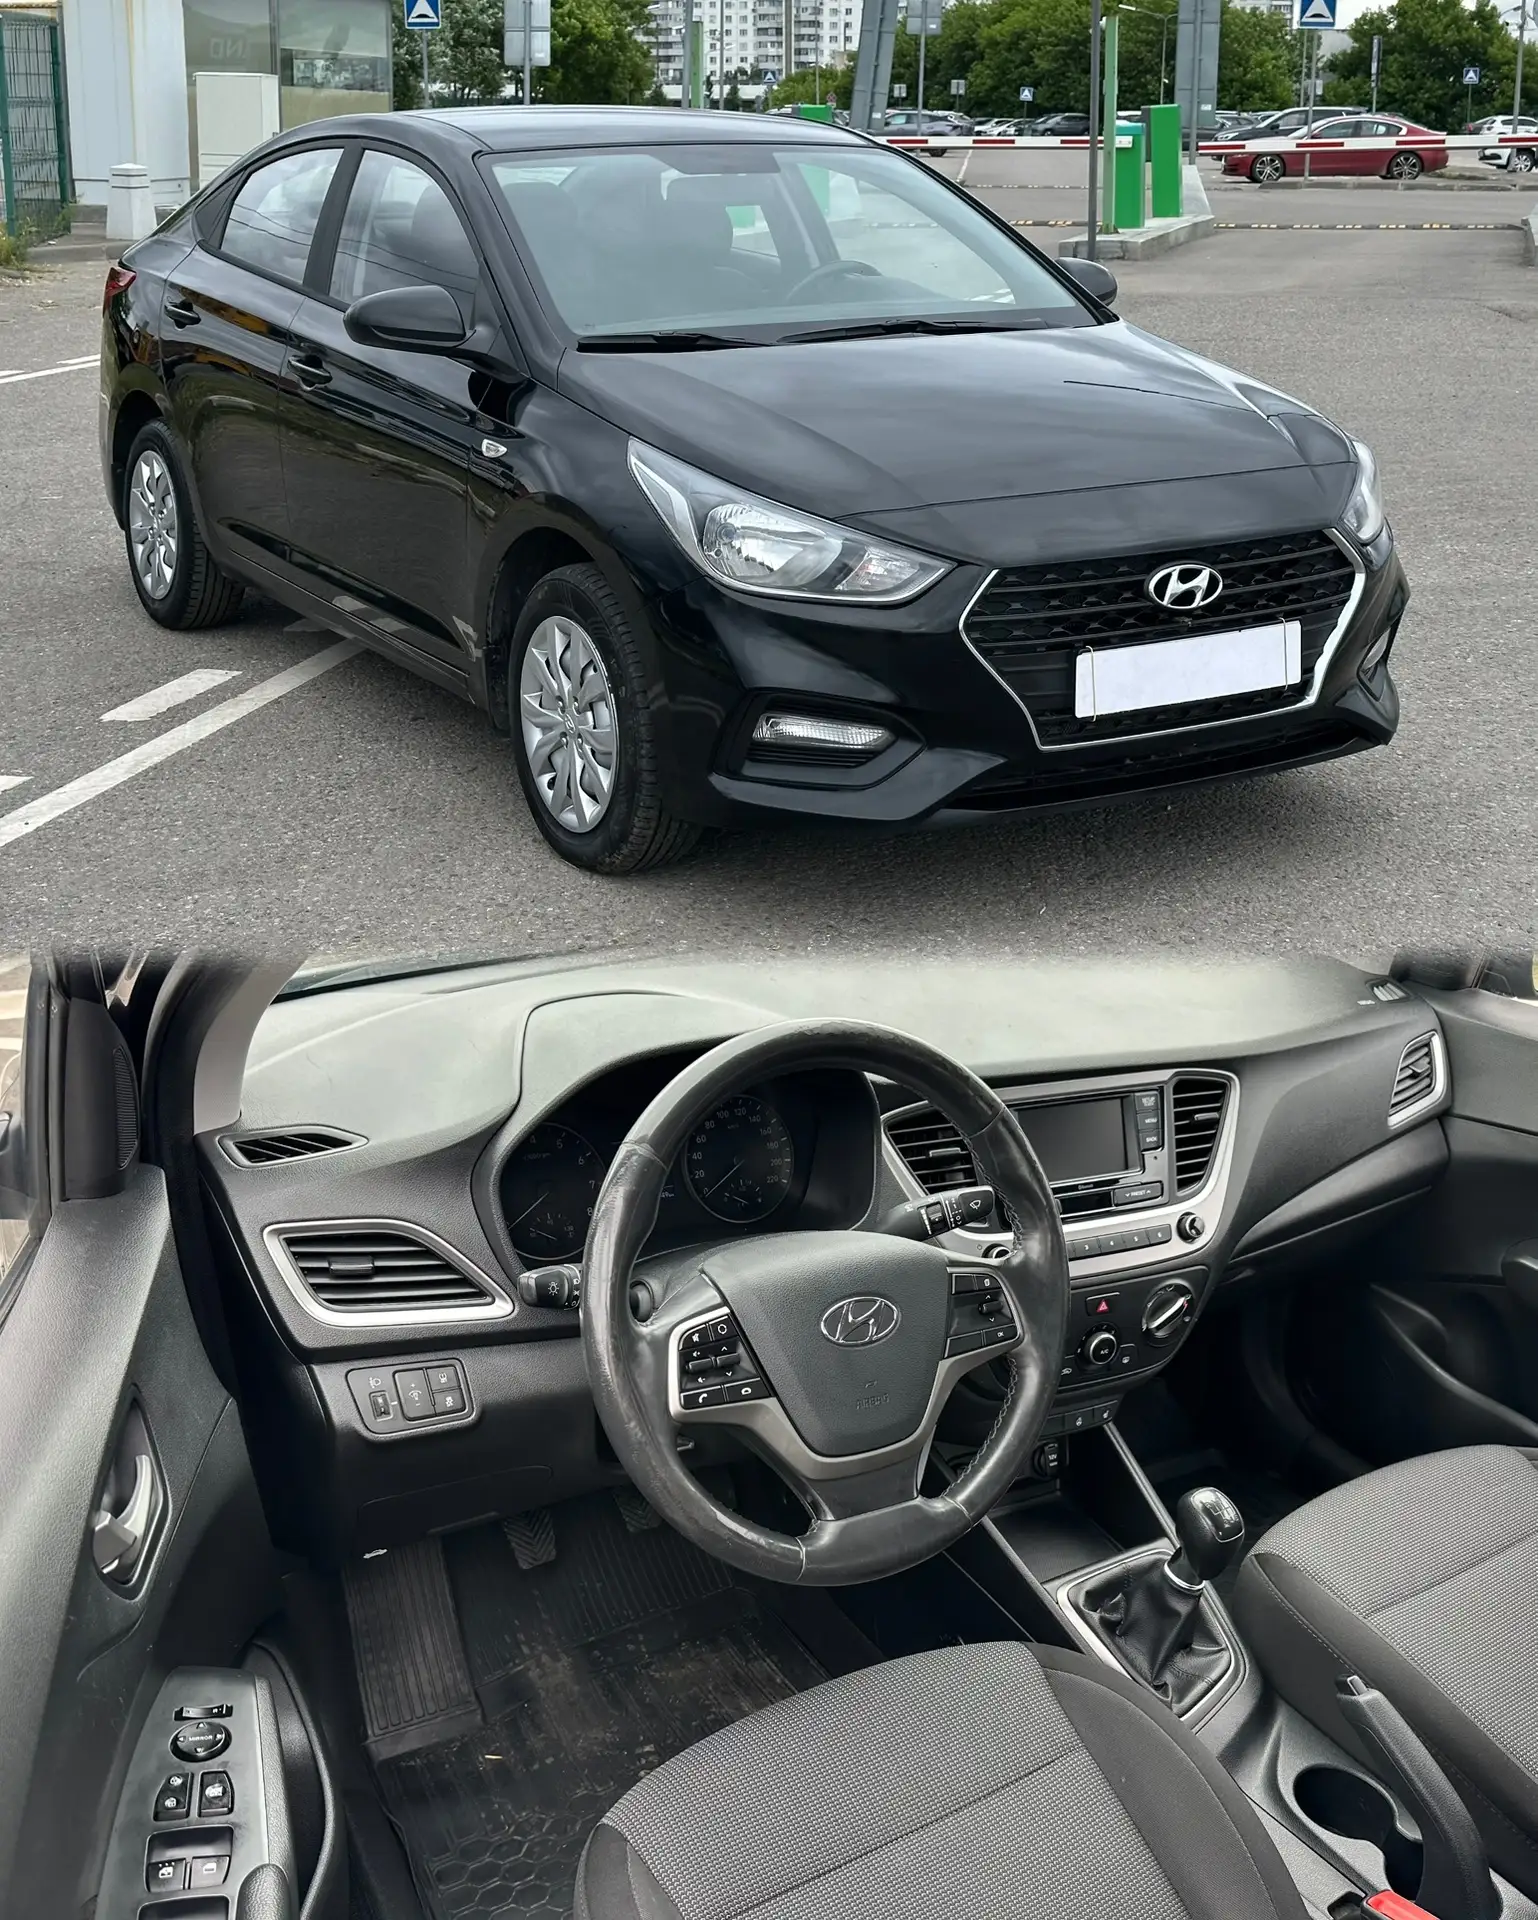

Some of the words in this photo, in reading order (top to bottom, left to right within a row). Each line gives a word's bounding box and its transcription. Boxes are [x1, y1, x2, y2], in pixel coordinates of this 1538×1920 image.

[716, 1110, 730, 1119] 100
[734, 1107, 747, 1116] 120
[748, 1114, 761, 1123] 140
[704, 1120, 715, 1129] 80
[760, 1127, 772, 1135] 160
[556, 1139, 563, 1149] 5
[696, 1135, 707, 1144] 60
[766, 1141, 779, 1149] 180
[692, 1152, 702, 1160] 40
[578, 1157, 584, 1165] 6
[770, 1158, 783, 1166] 200
[694, 1170, 705, 1179] 20
[588, 1180, 595, 1189] 7
[766, 1176, 779, 1184] 220
[587, 1207, 593, 1216] 8
